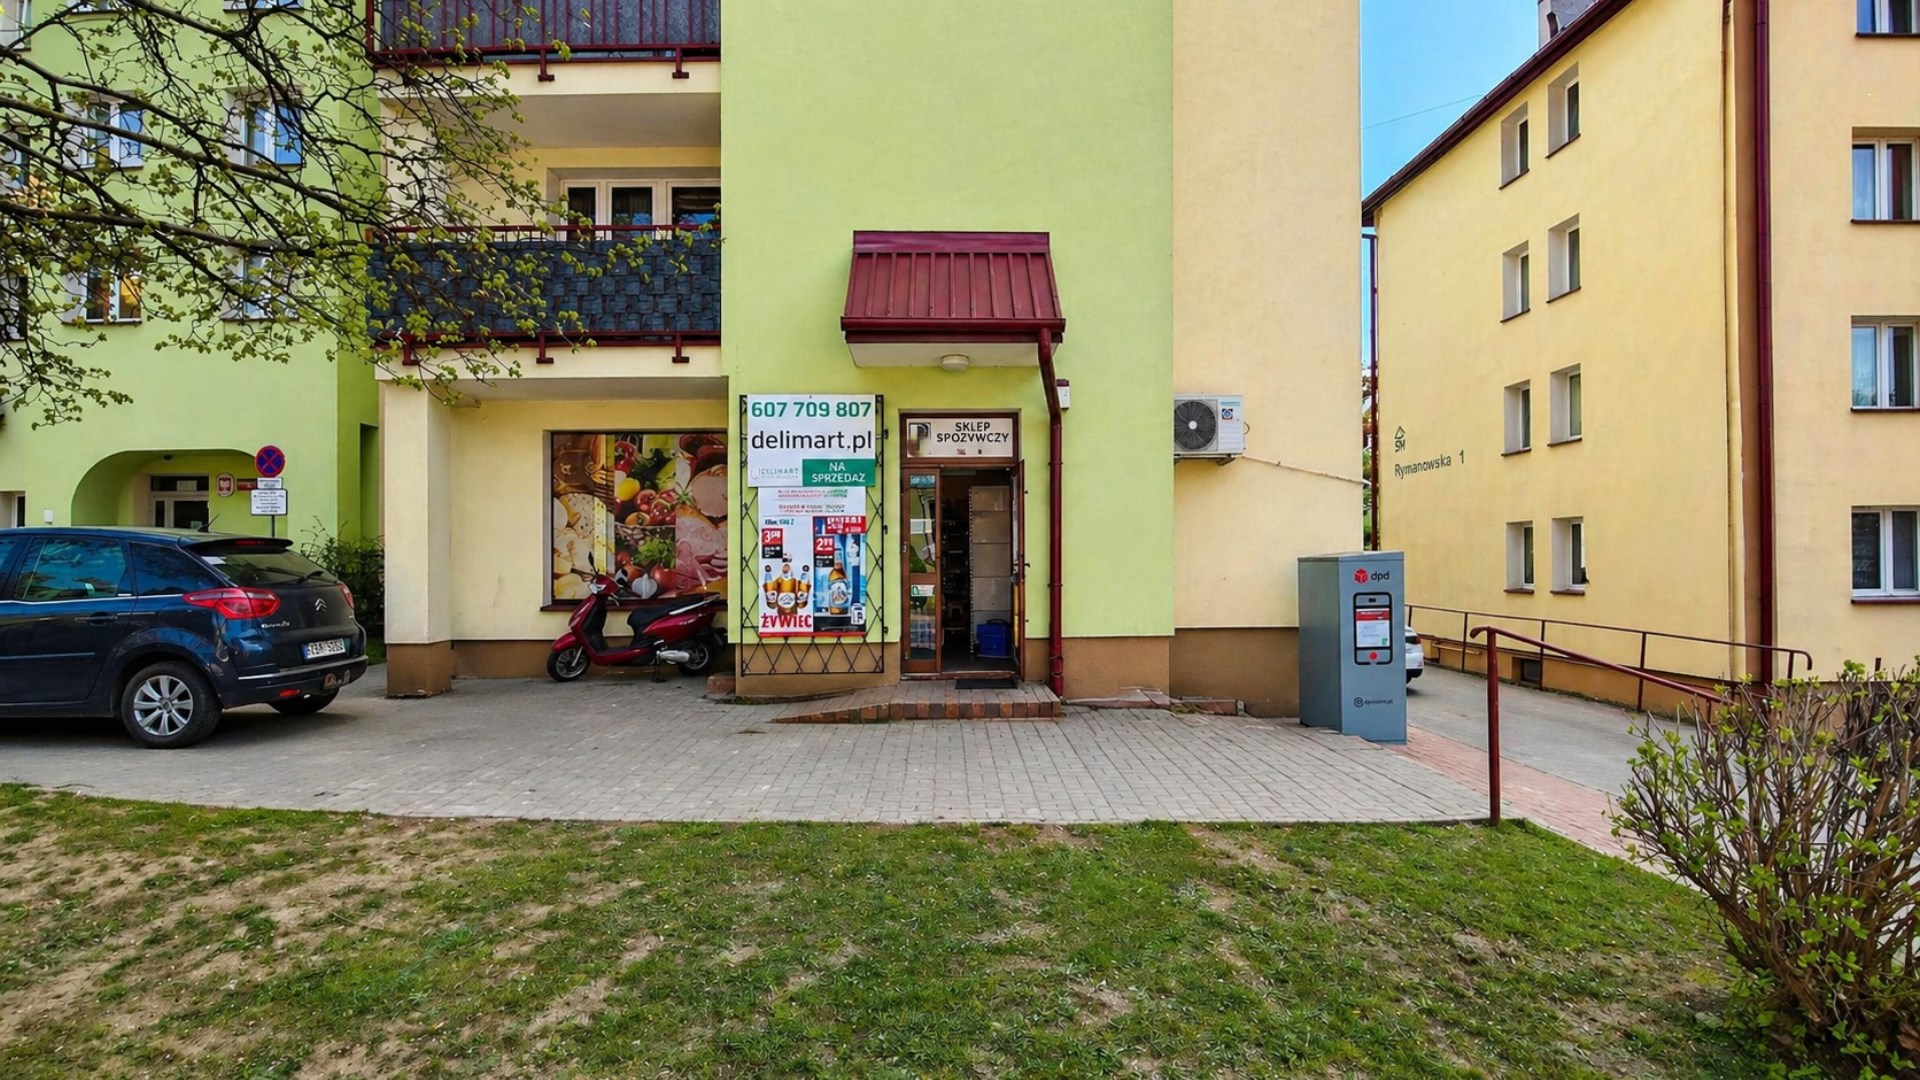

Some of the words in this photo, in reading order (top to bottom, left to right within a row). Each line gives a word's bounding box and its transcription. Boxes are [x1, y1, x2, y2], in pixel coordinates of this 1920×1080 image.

[751, 402, 788, 417] 607
[793, 402, 830, 417] 709
[836, 402, 871, 417] 807
[955, 422, 991, 432] SKLEP
[751, 430, 872, 453] delimart.pl
[829, 462, 846, 471] NA
[1394, 454, 1452, 480] Rymanowska
[1459, 449, 1464, 464] 1
[1370, 571, 1390, 582] dpd
